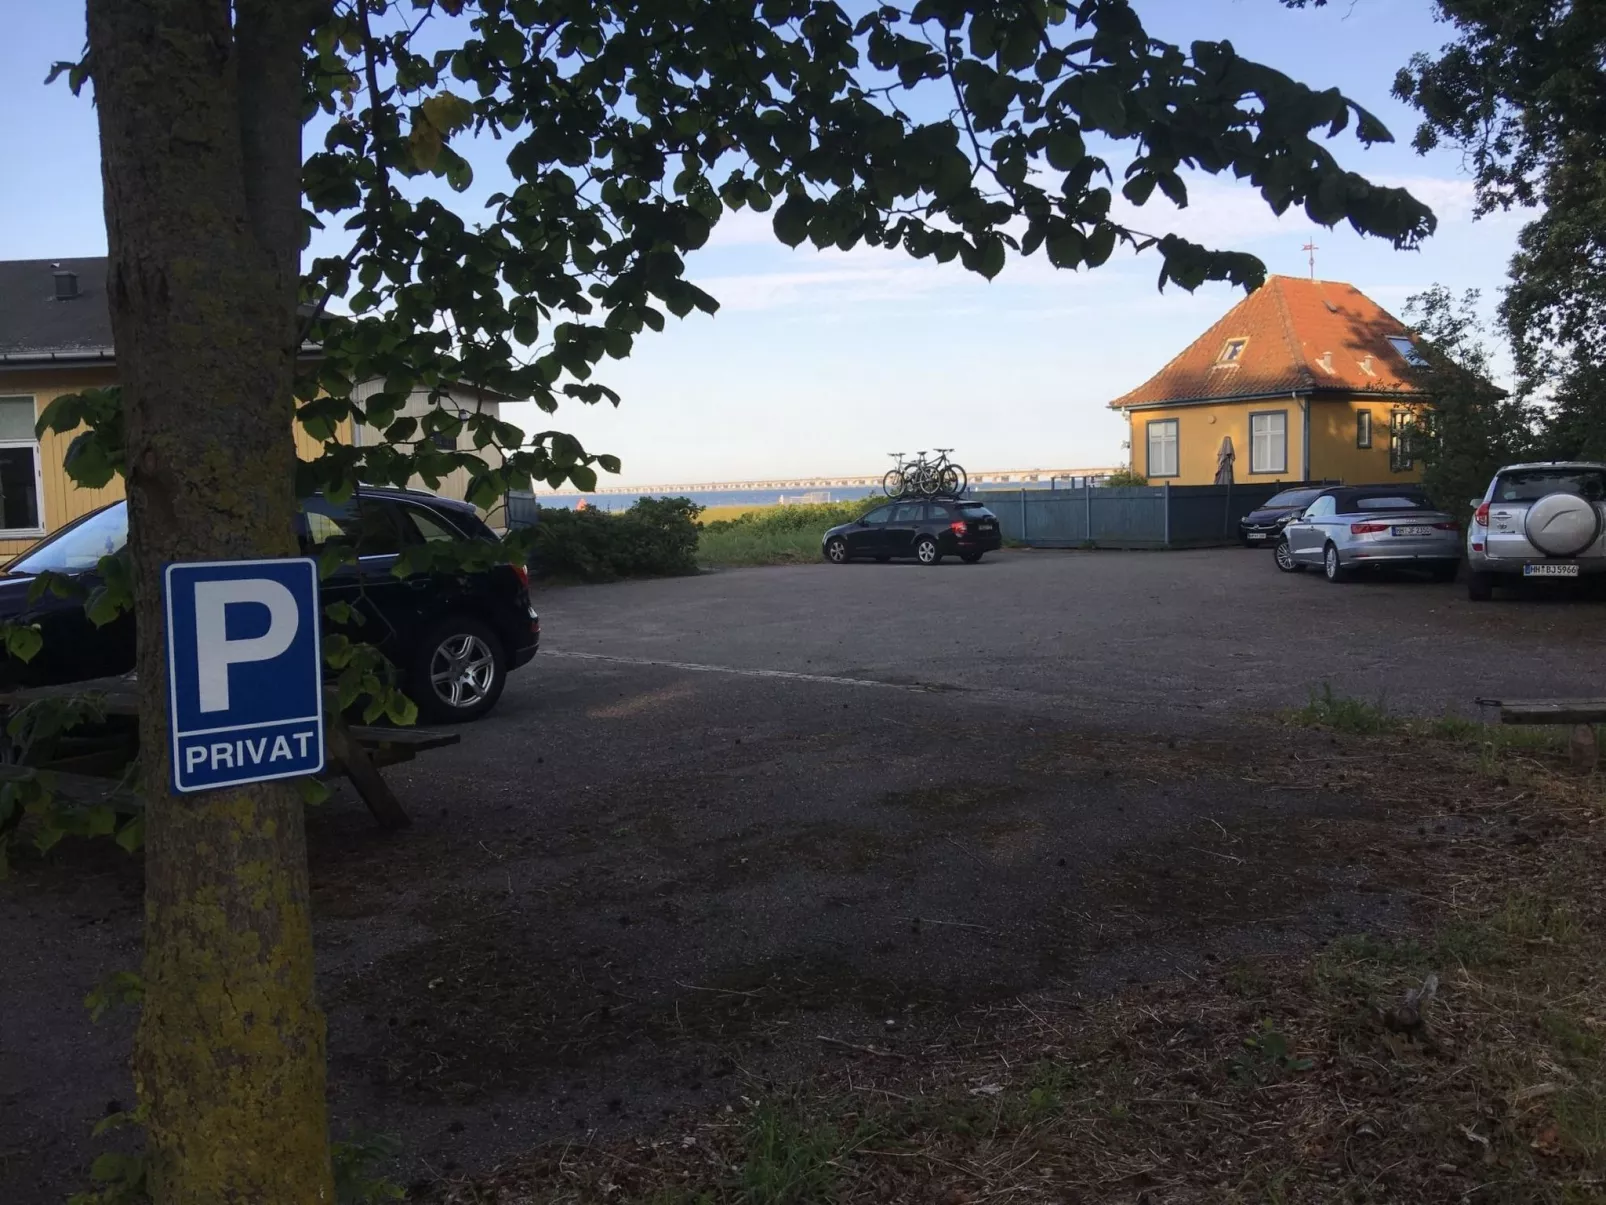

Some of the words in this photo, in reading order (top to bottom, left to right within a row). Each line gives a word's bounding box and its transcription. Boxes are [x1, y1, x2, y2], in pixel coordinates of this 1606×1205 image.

[1530, 565, 1540, 574] HH
[194, 578, 299, 713] P
[185, 731, 314, 774] PRIVAT
